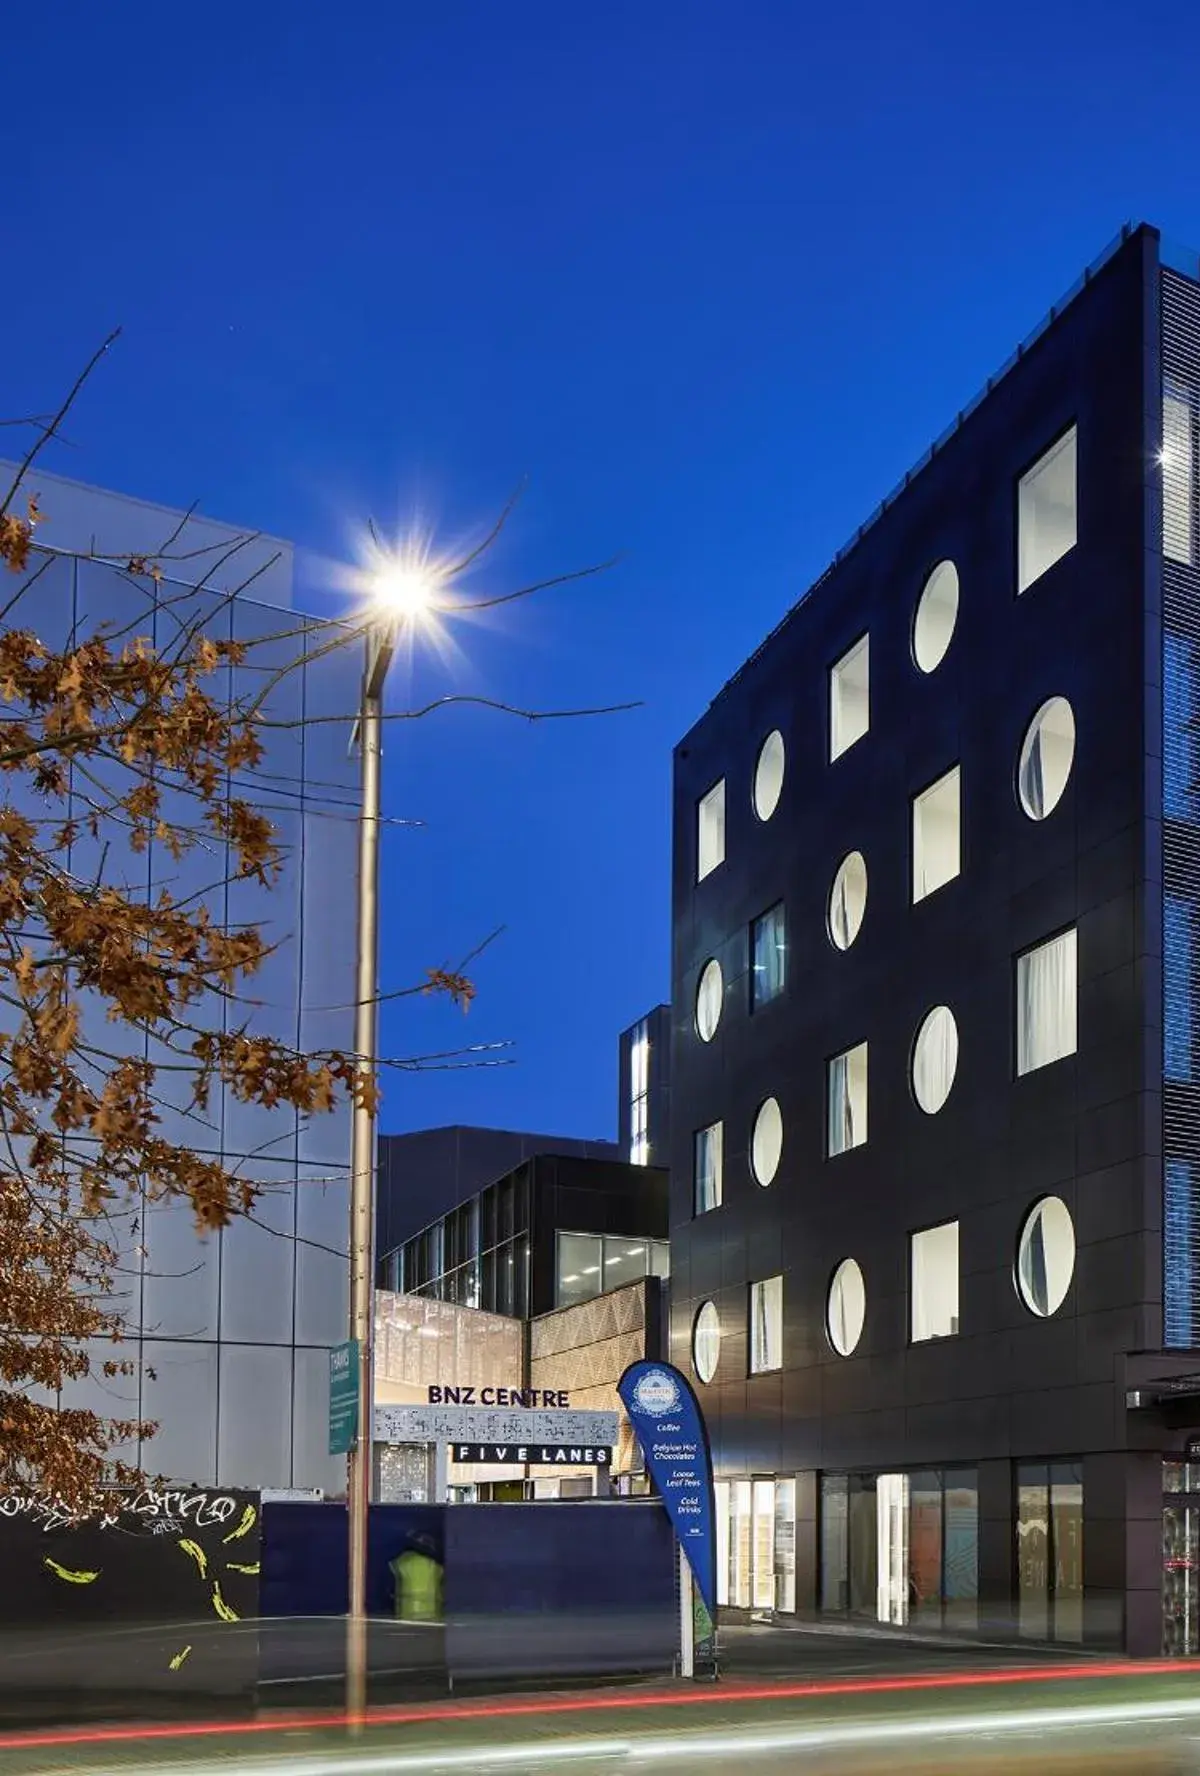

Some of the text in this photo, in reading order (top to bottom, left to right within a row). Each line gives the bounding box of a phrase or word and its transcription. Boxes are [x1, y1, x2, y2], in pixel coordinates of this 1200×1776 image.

[428, 1385, 570, 1408] BNZ CENTRE
[656, 1423, 681, 1432] Coffee
[459, 1447, 607, 1463] FIVE LANES
[653, 1452, 696, 1460] Chocolates
[680, 1497, 699, 1505] Cold
[677, 1506, 702, 1514] Drinks
